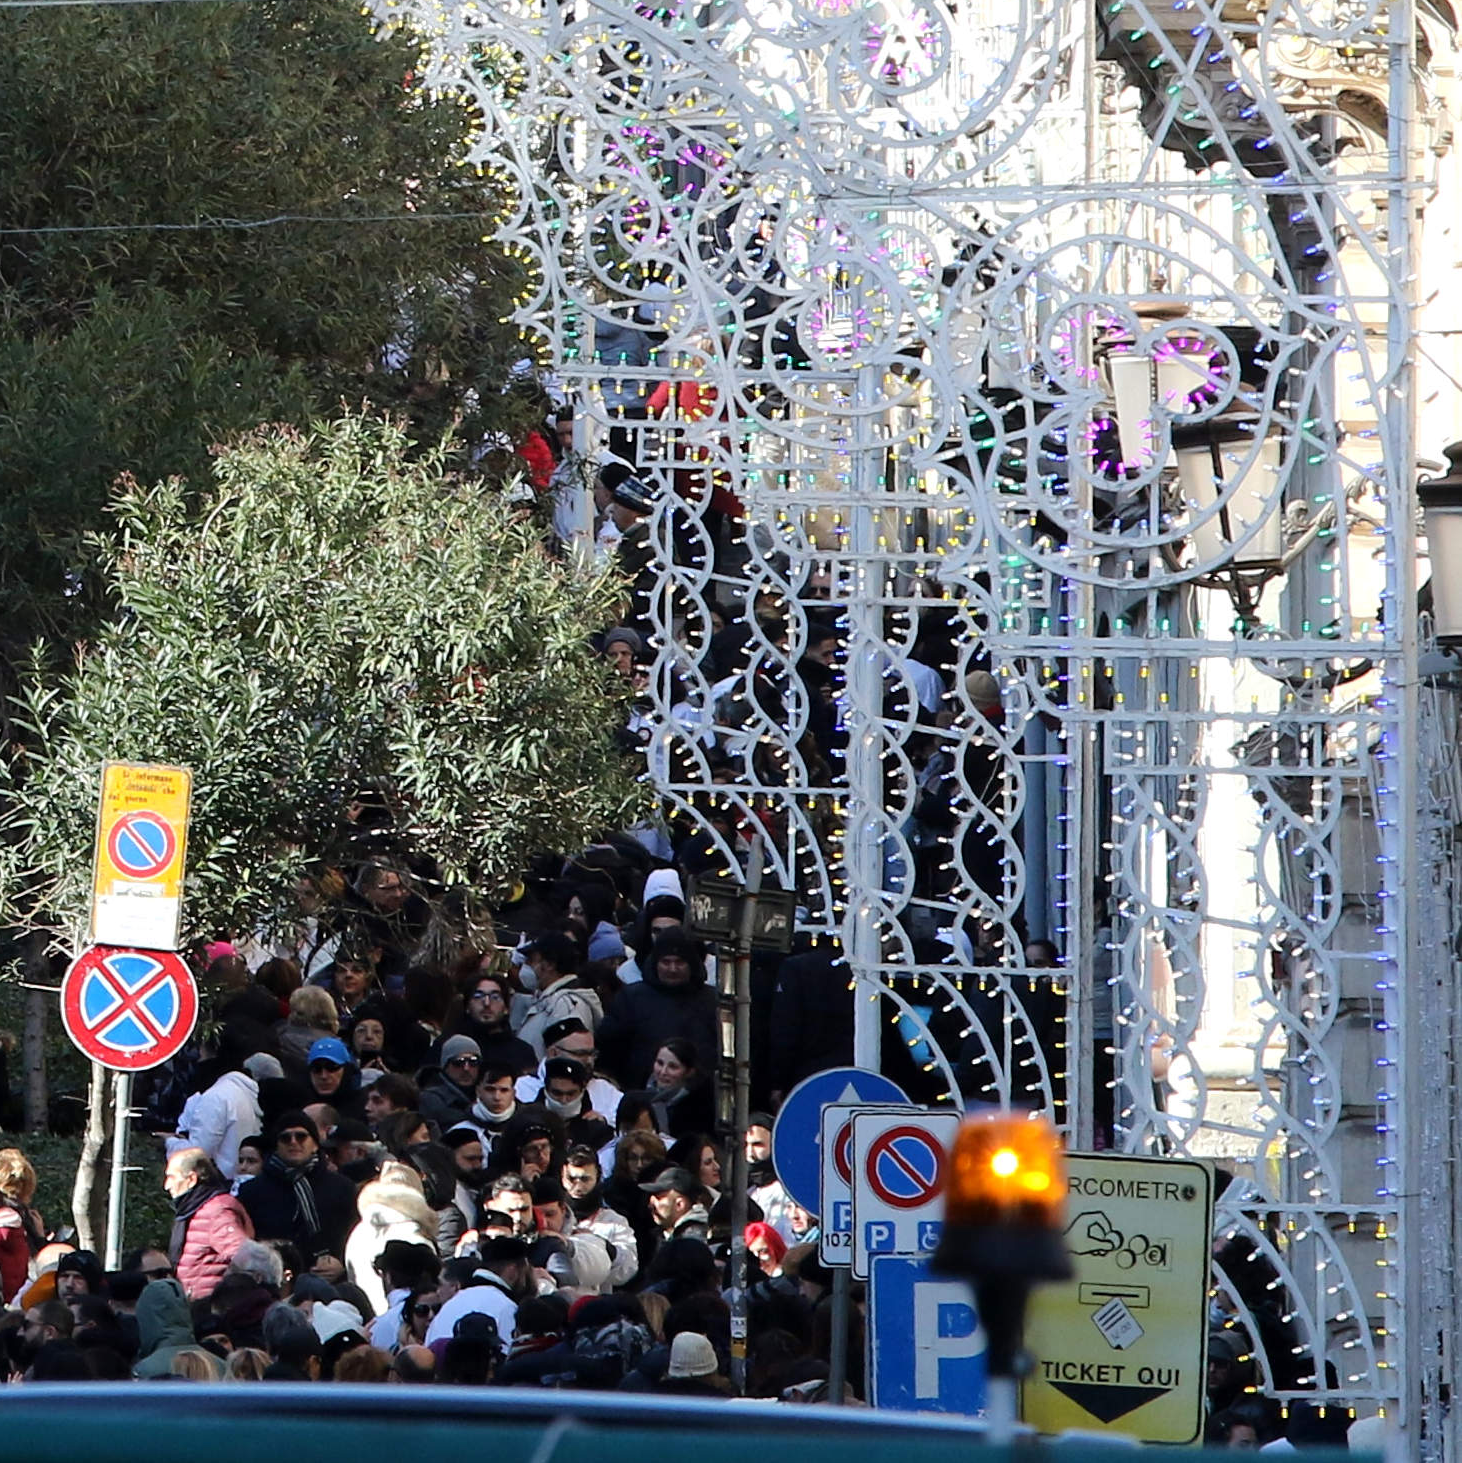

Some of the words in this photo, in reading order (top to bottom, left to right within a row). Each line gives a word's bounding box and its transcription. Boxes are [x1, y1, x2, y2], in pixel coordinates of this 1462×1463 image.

[871, 1226, 889, 1249] P
[914, 1281, 989, 1399] P
[1041, 1361, 1126, 1383] TICKET
[1137, 1367, 1180, 1386] QUI
